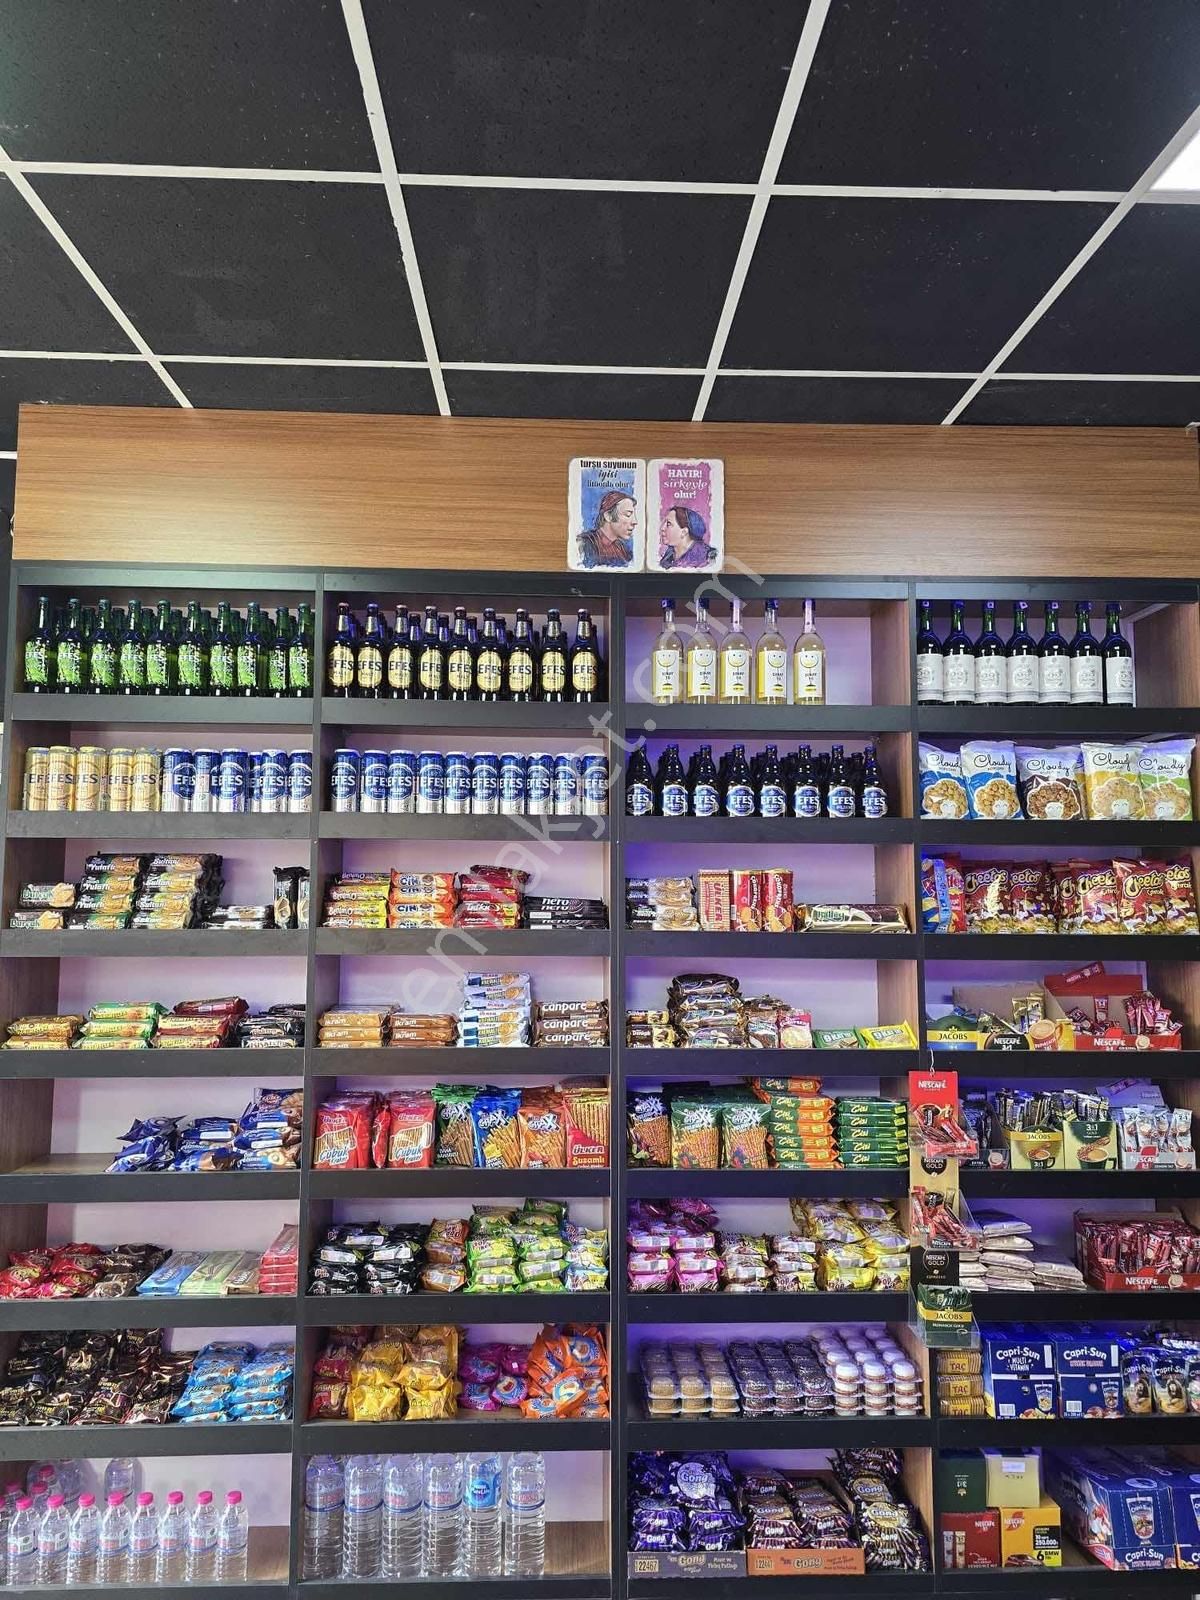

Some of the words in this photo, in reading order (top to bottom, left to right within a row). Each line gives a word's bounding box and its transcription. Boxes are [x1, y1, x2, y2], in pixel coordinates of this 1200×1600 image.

[603, 460, 637, 470] suyunun
[668, 469, 703, 478] HAYIR!
[663, 479, 708, 490] sirkeyle
[674, 491, 697, 499] olur!
[542, 664, 566, 675] EFES
[574, 665, 596, 675] EFES
[974, 753, 1012, 773] Cloudy
[1026, 759, 1070, 776] Cloudy
[472, 778, 497, 789] EFES
[627, 794, 649, 804] EFES
[665, 795, 686, 804] EFES
[694, 795, 716, 804] EFES
[733, 795, 753, 805] EFES
[760, 796, 783, 805] EFES
[798, 796, 819, 806] EFES
[832, 796, 854, 806] EFES
[863, 797, 886, 807] EFES
[965, 868, 1008, 893] Cheetos
[541, 897, 569, 906] nero
[713, 882, 724, 922] ÜLKER
[542, 1001, 587, 1013] canpare
[543, 1019, 589, 1031] canpare
[545, 1032, 590, 1044] canpare
[993, 1036, 1020, 1045] NESCAFÉ
[918, 1080, 948, 1089] NESCAFÉ
[572, 1145, 605, 1154] ÜLKER
[572, 1155, 605, 1166] Susamlı
[935, 1312, 964, 1320] JACOBS
[996, 1346, 1040, 1361] Capri-Sun
[1063, 1346, 1107, 1361] Capri-Sun
[681, 1470, 708, 1483] Gong
[760, 1485, 777, 1494] Gong
[857, 1484, 884, 1493] Gong
[872, 1509, 898, 1517] Gong
[817, 1520, 835, 1529] Gong
[765, 1526, 784, 1535] Gong
[646, 1534, 665, 1543] Gong
[880, 1533, 898, 1541] Gong
[1036, 1550, 1044, 1560] 6
[1125, 1548, 1164, 1562] Capri-Sun
